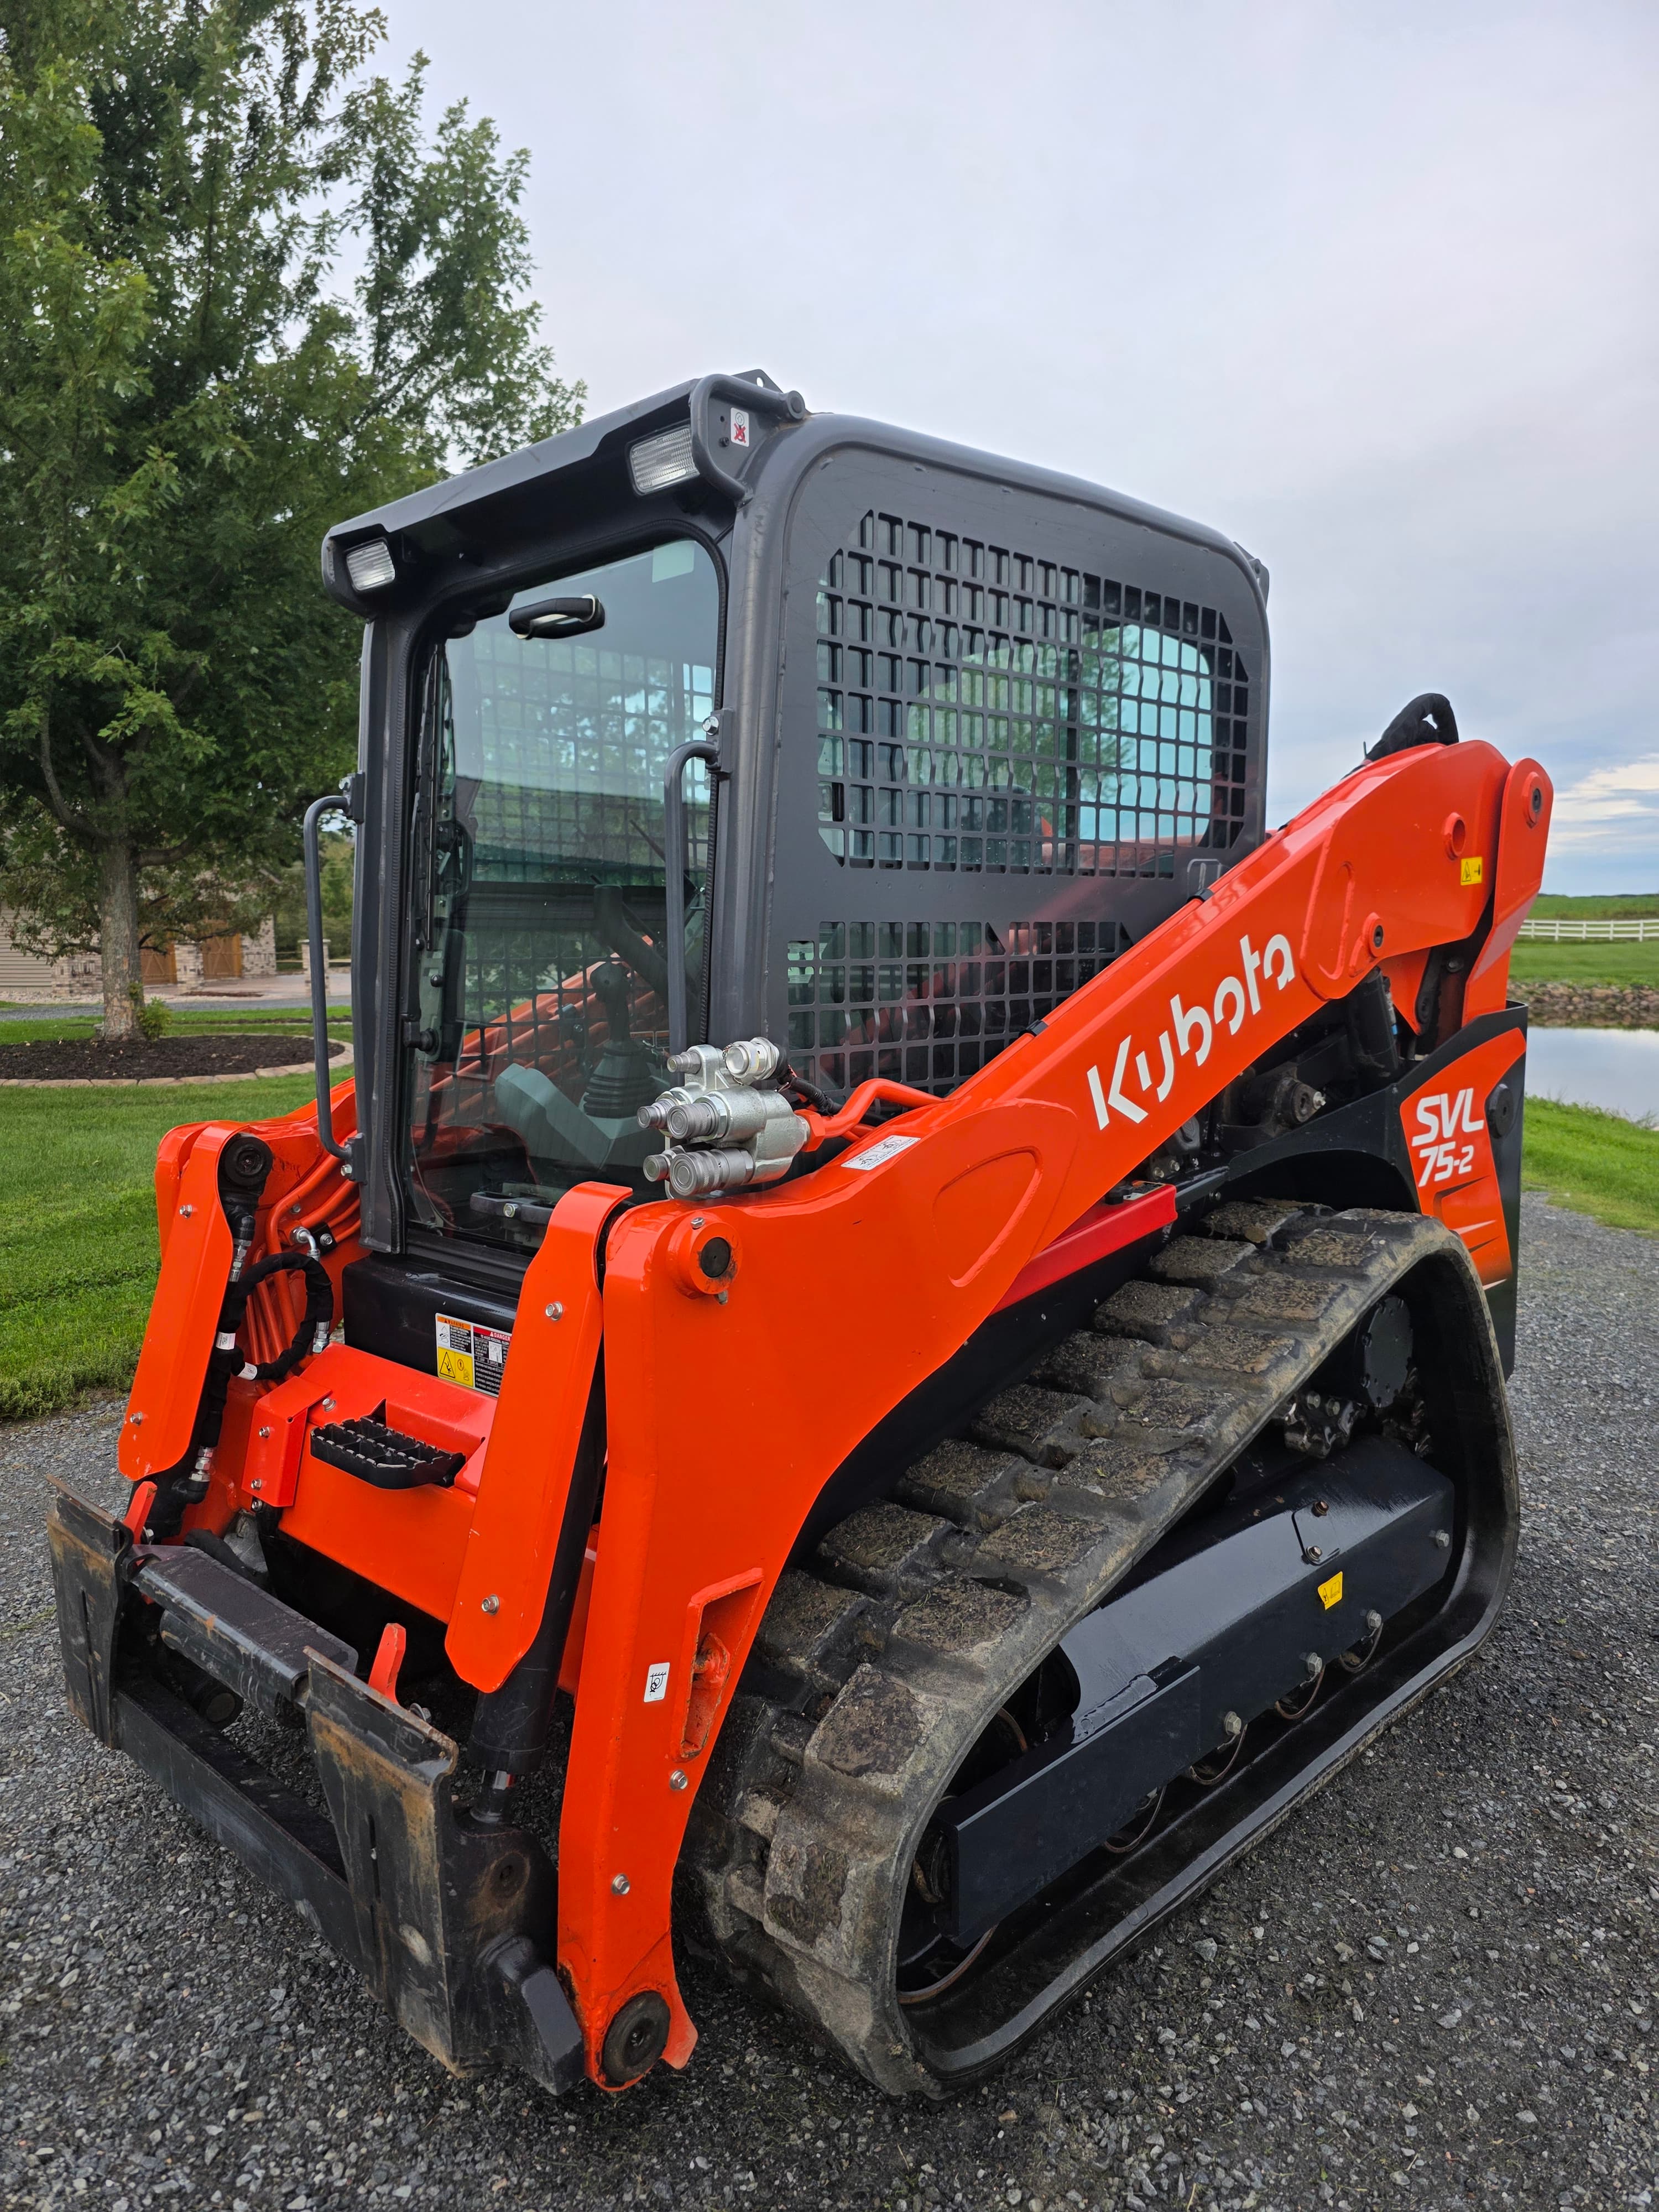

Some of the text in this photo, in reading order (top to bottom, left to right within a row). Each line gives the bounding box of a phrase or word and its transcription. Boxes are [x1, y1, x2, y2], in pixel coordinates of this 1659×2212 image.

[1086, 933, 1296, 1131] Kubota
[1411, 1087, 1484, 1147] SVL
[1418, 1141, 1474, 1187] 75-2
[494, 1332, 511, 1342] DANGER
